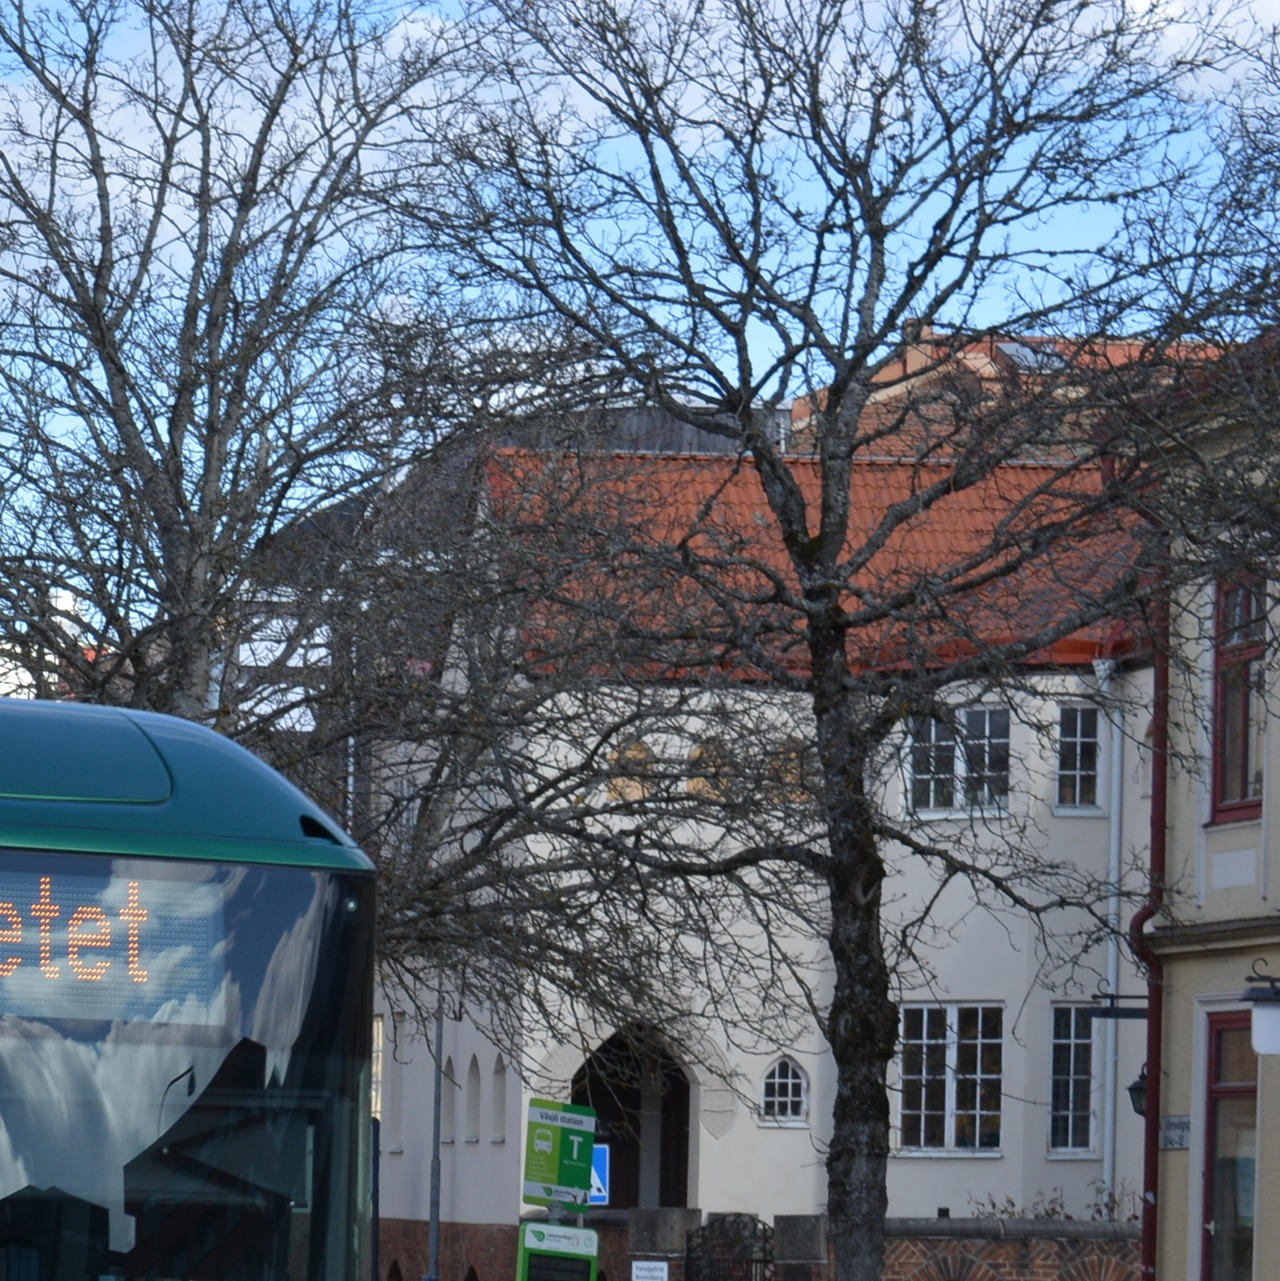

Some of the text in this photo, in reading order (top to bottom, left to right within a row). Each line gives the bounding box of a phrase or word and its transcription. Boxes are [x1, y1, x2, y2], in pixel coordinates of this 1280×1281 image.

[539, 1111, 584, 1127] Växjö station
[568, 1134, 583, 1160] T
